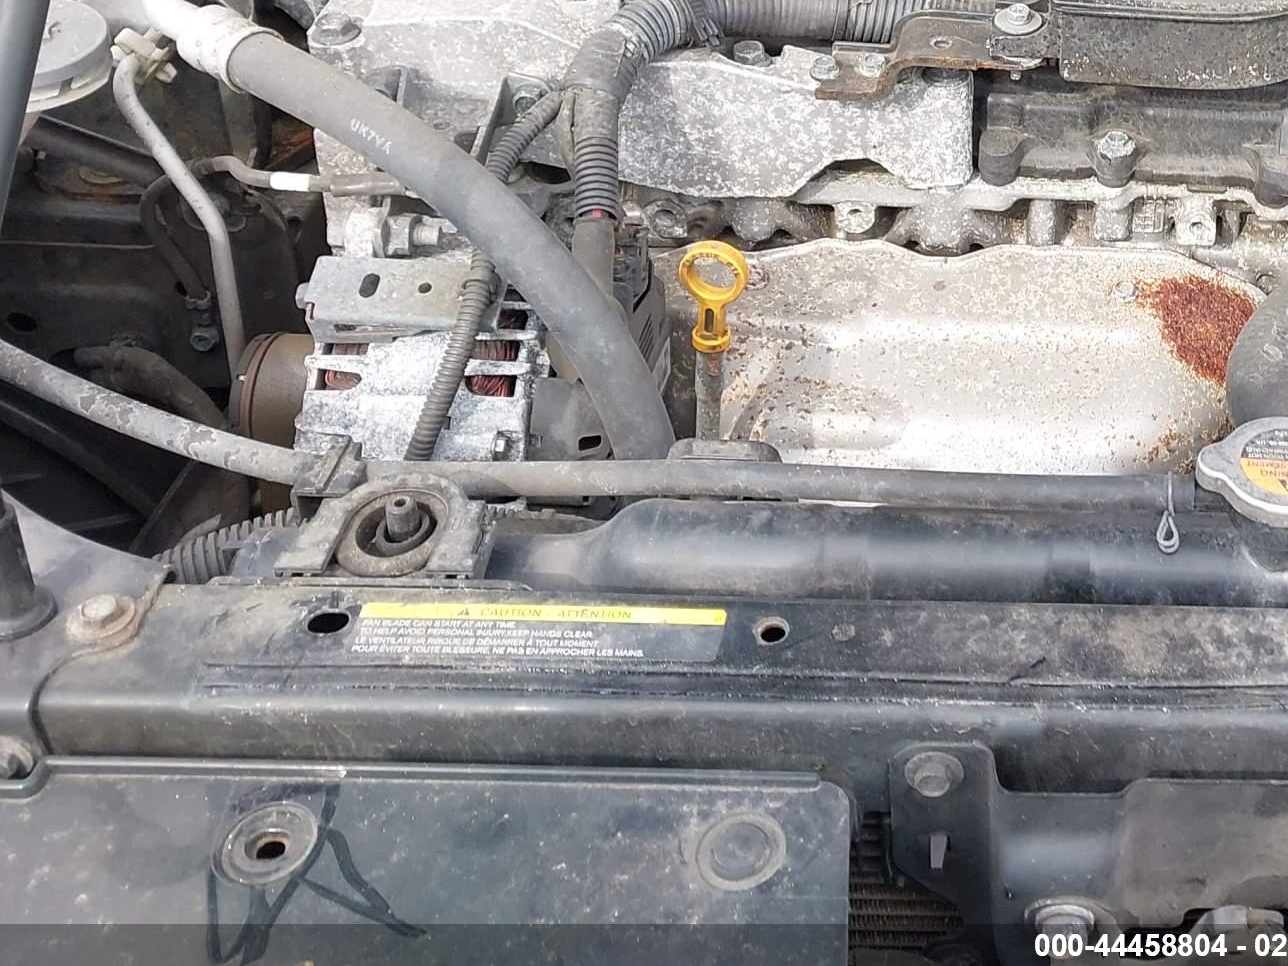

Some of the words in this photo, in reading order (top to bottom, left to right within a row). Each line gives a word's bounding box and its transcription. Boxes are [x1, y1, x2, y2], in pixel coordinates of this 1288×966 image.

[480, 607, 542, 618] CAUTION
[558, 608, 632, 620] ATTENTION
[362, 618, 381, 627] FAN
[382, 618, 411, 627] BLADE
[412, 619, 433, 627] CAN
[433, 619, 461, 628] START
[461, 620, 474, 628] AT
[474, 620, 495, 628] ANY
[360, 627, 372, 635] TO
[372, 627, 397, 635] HELP
[397, 628, 426, 636] AVOID
[426, 628, 474, 636] PERSONAL
[530, 630, 562, 638] HANDS
[354, 636, 367, 645] LE
[368, 636, 426, 646] VENTILATEUR
[426, 637, 462, 646] RISQUE
[462, 637, 476, 646] DE
[476, 636, 526, 647] DÉMARRER
[534, 639, 560, 648] TOUT
[351, 644, 379, 653] POUR
[379, 643, 411, 653] ÉVITER
[412, 645, 441, 654] TOUTE
[491, 647, 506, 655] NE
[506, 647, 525, 656] PAS
[525, 648, 539, 656] EN
[539, 648, 596, 658] APPROCHER
[596, 649, 614, 657] LES
